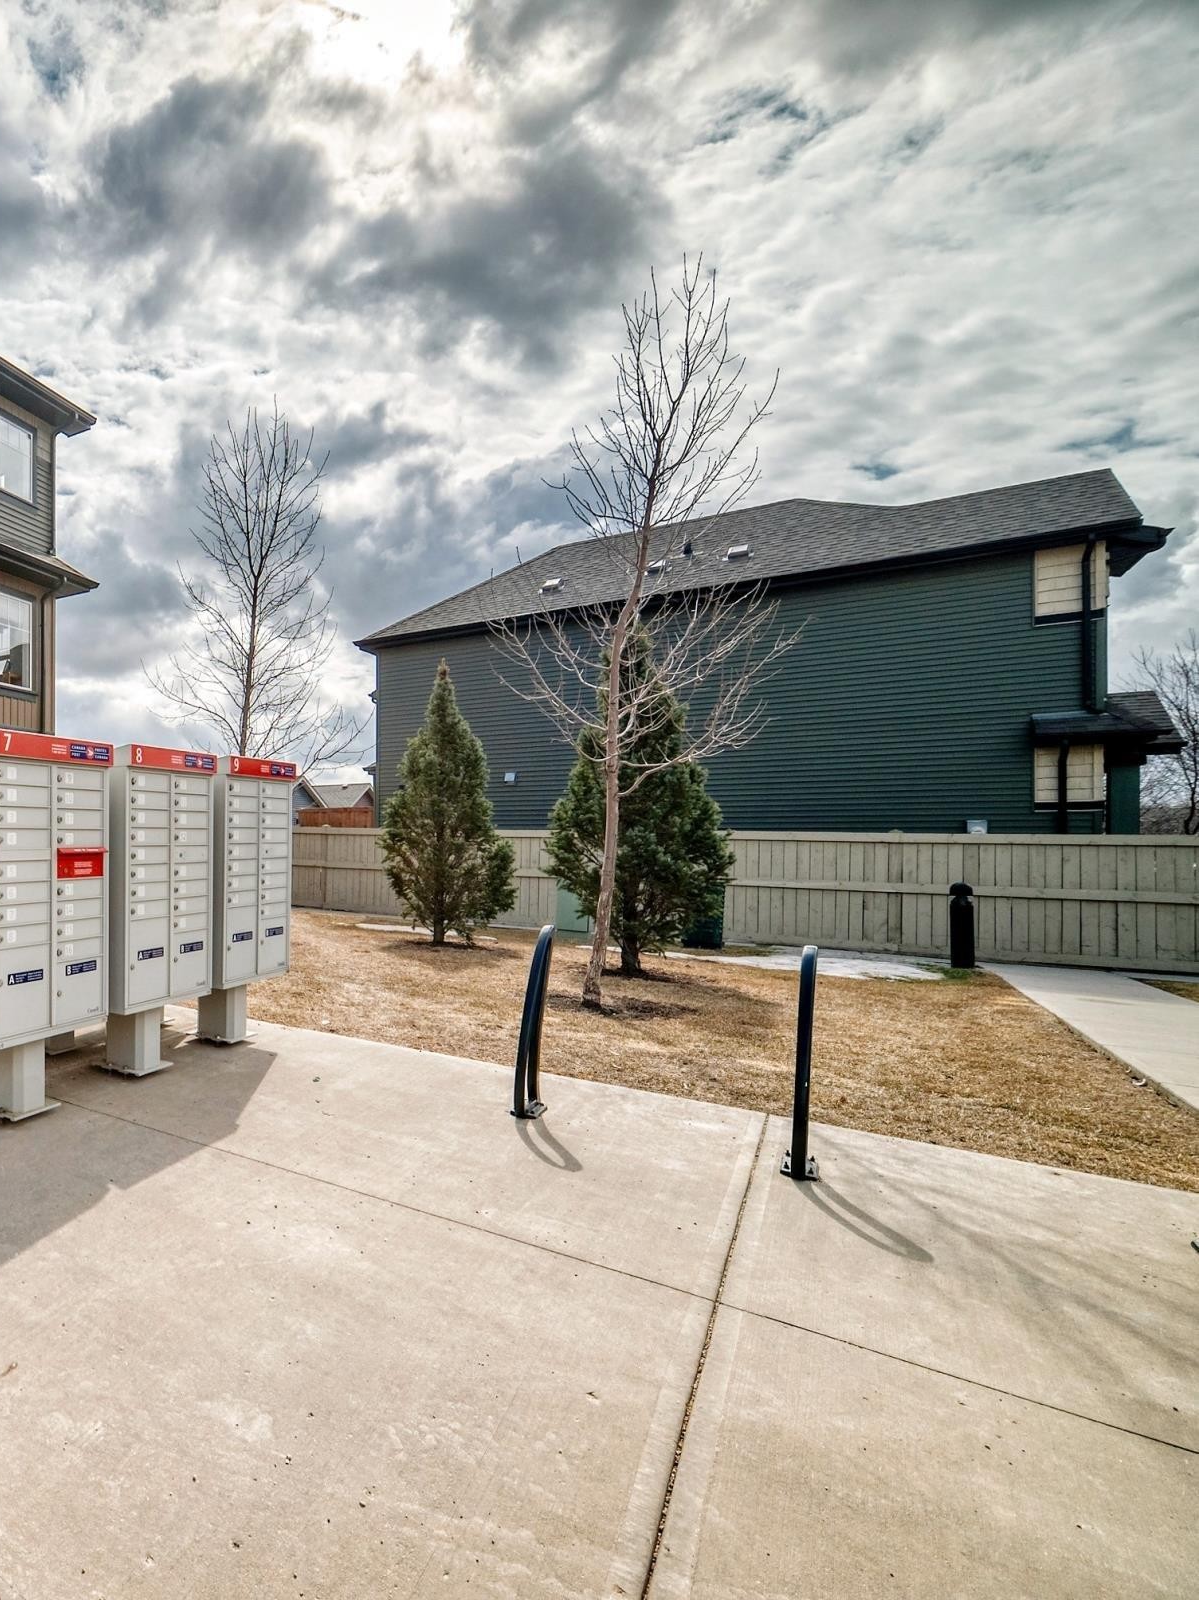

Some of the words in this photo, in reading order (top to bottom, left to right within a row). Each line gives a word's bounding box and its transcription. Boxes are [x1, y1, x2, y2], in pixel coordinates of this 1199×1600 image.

[3, 733, 12, 751] 7
[135, 747, 143, 763] 8
[233, 758, 240, 772] 9
[138, 951, 143, 960] A
[66, 965, 72, 975] B
[8, 975, 15, 985] A
